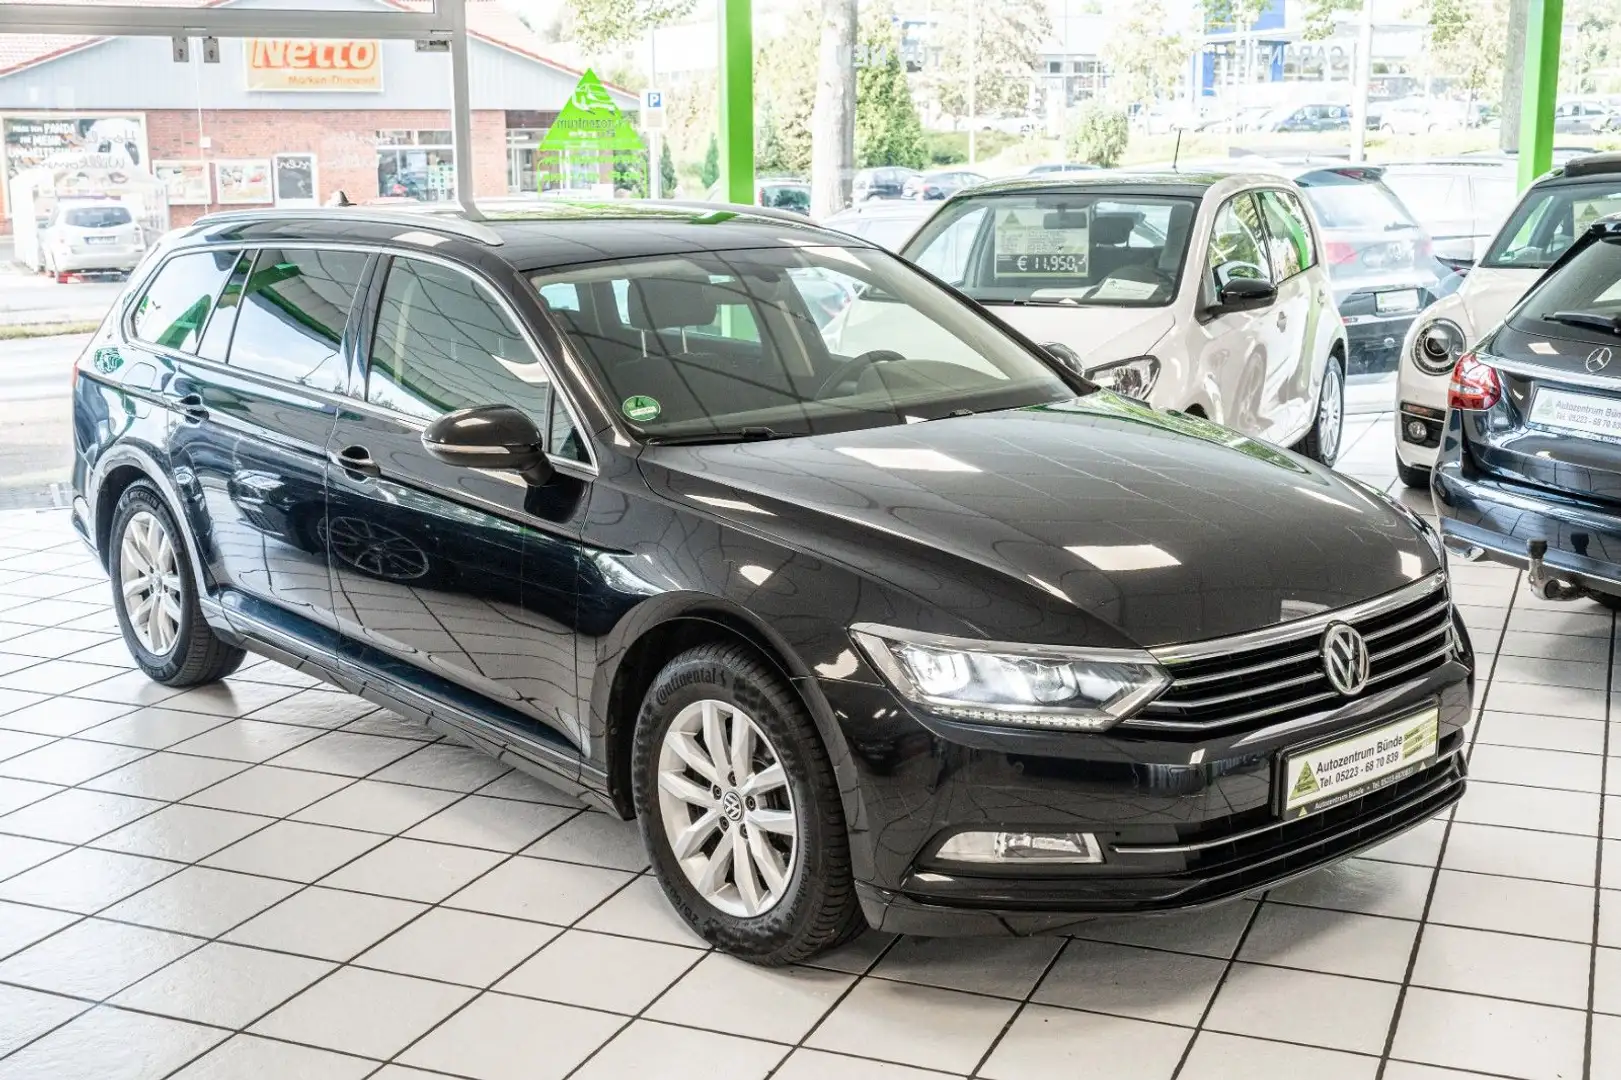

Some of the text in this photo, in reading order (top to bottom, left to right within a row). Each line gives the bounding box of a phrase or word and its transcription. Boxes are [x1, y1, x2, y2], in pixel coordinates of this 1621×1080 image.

[252, 39, 377, 69] Netto
[1017, 256, 1028, 271] €
[656, 667, 717, 706] Continental
[1315, 745, 1375, 775] Autozentrum
[1376, 732, 1403, 754] Bünde
[1319, 775, 1334, 789] Tel.
[1335, 765, 1359, 784] 05223
[1365, 760, 1374, 772] 68
[1376, 756, 1385, 768] 70
[1386, 750, 1399, 765] 839
